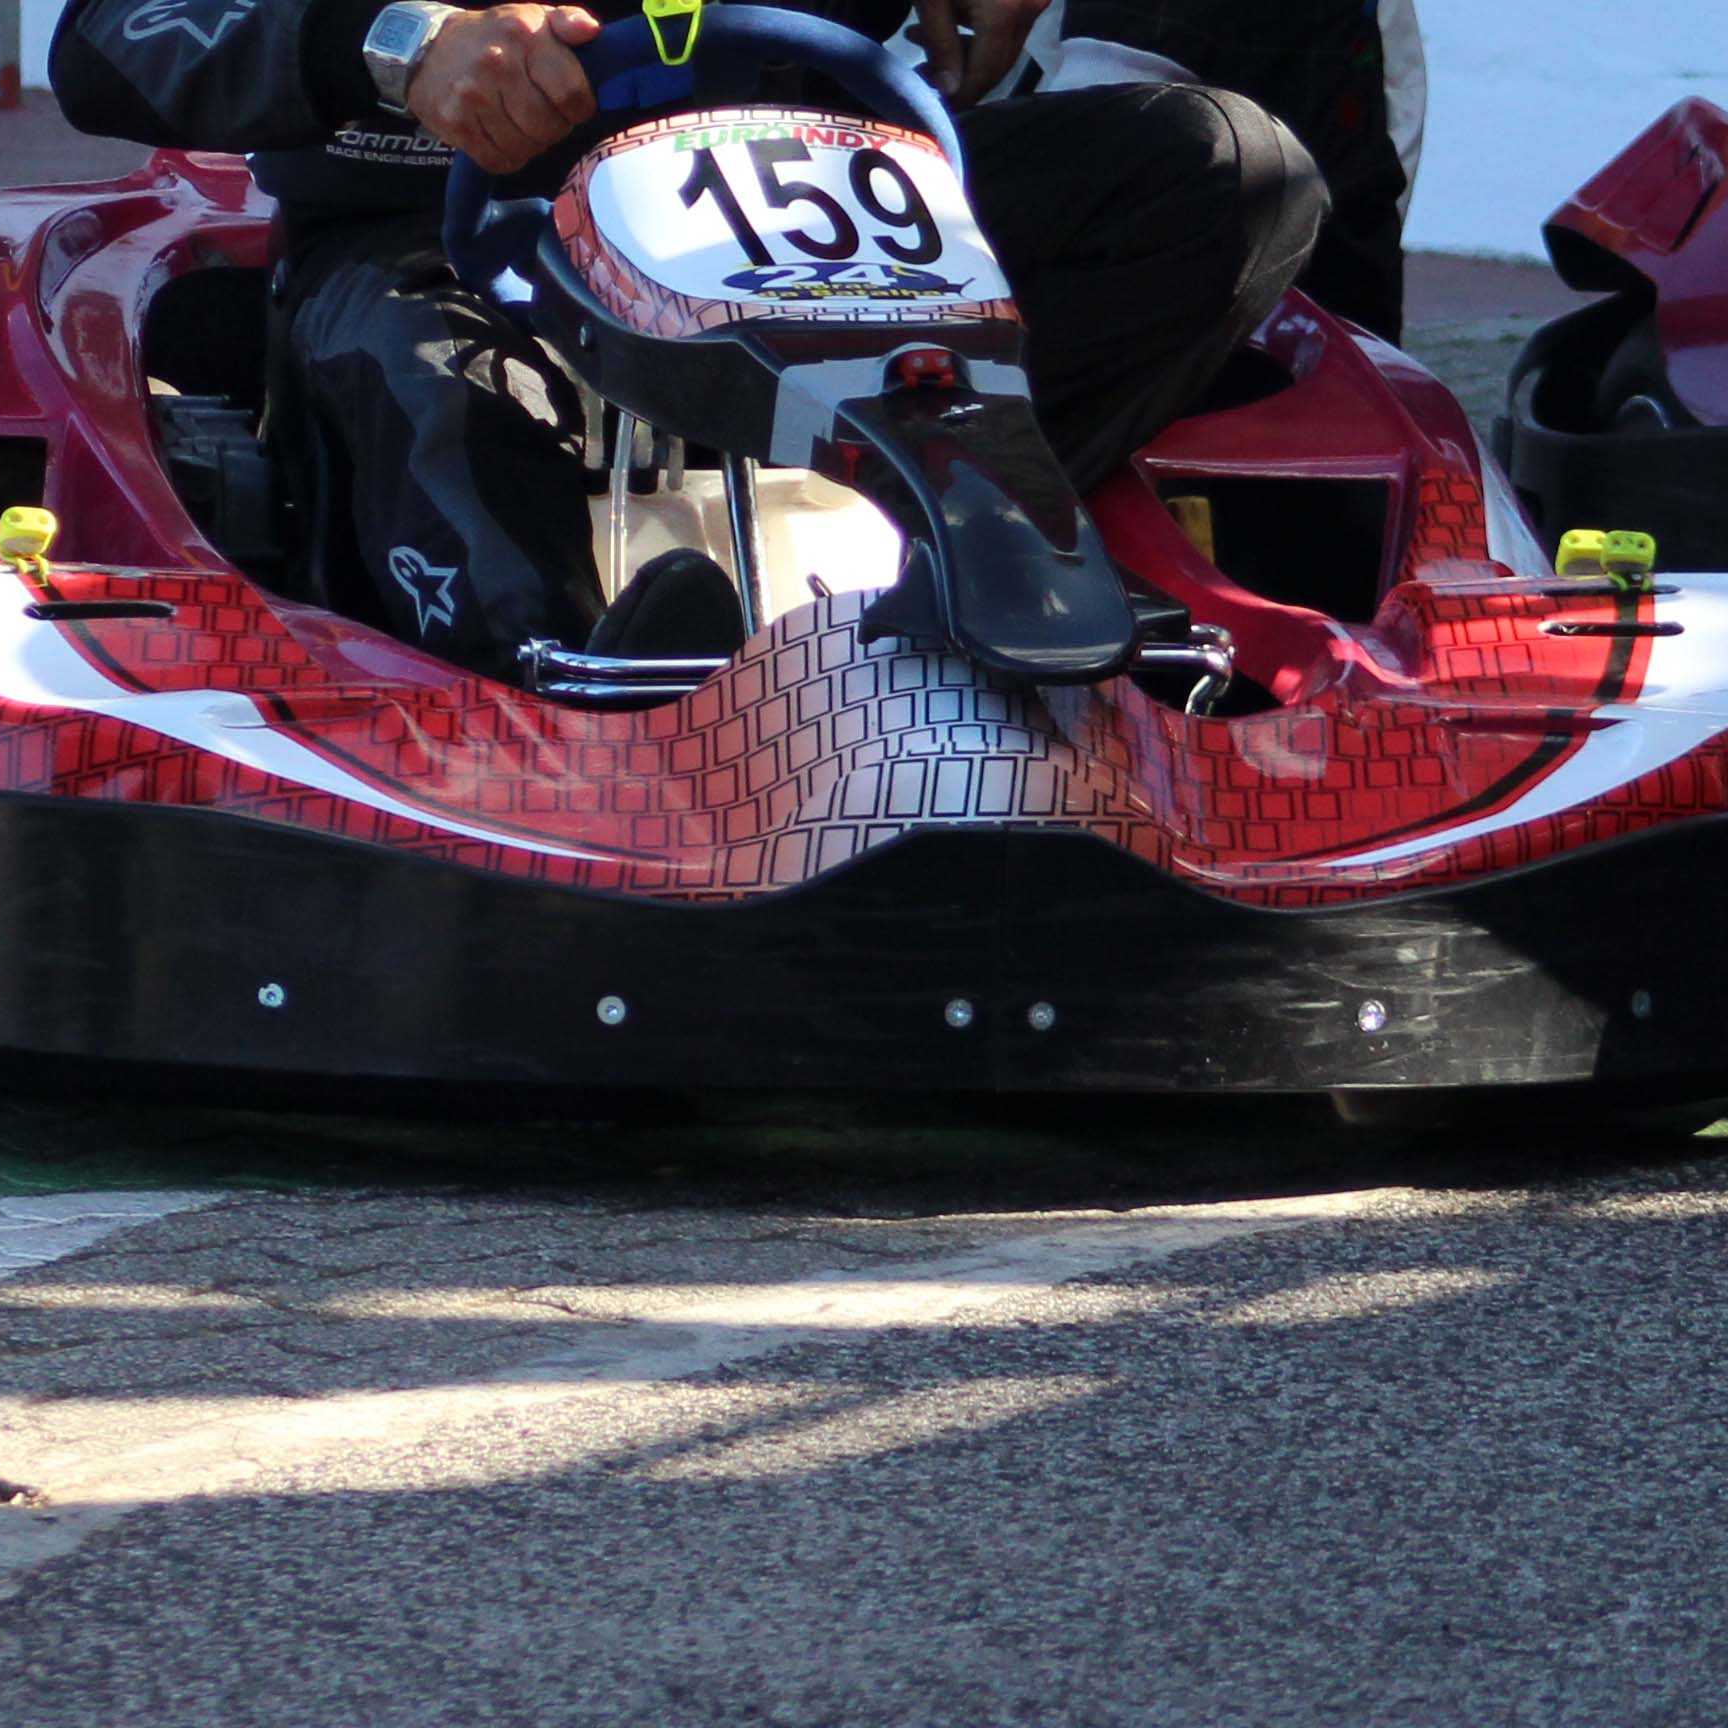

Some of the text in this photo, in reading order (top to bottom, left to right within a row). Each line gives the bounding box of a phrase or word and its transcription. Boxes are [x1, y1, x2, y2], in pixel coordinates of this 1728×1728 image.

[675, 126, 889, 152] EUROINDY
[326, 145, 454, 167] RACE ENGINEERIN
[678, 137, 942, 266] 159
[756, 264, 898, 288] 24
